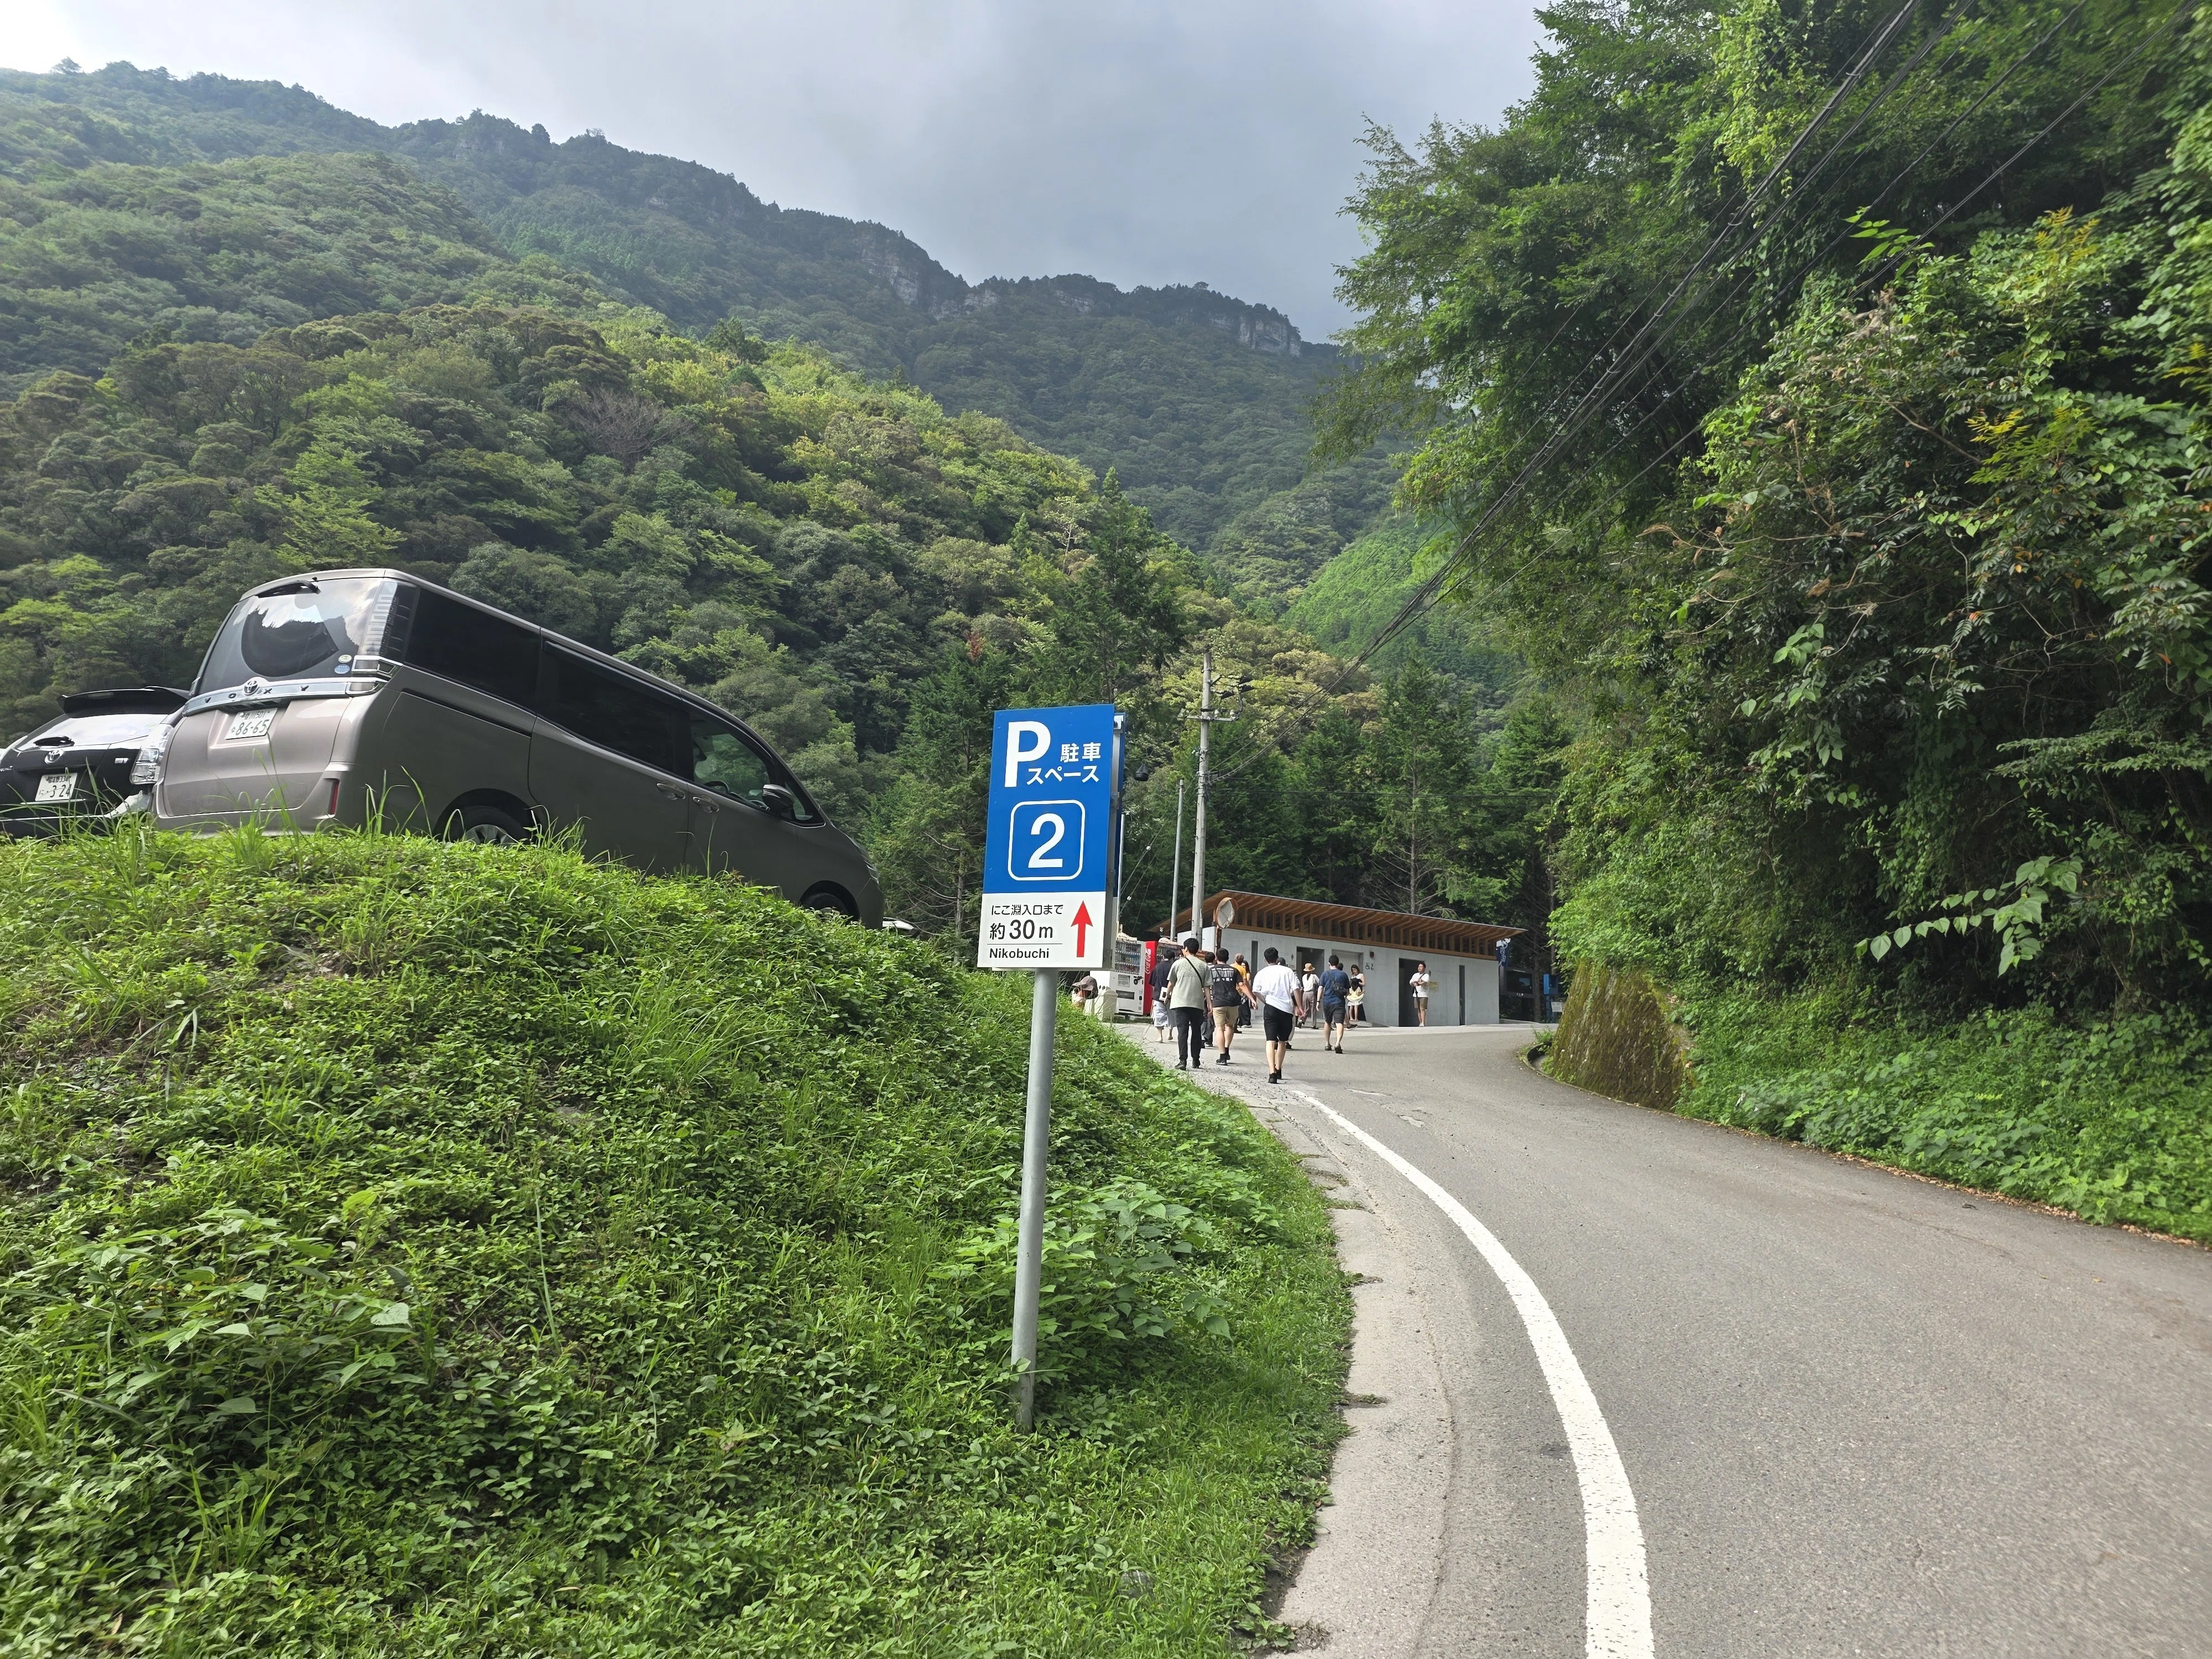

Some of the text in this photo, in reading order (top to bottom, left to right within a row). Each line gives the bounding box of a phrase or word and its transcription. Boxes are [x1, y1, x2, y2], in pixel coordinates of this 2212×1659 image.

[205, 685, 309, 703] VOXY
[1004, 721, 1051, 787] P
[1060, 742, 1101, 763] 駐車
[1026, 765, 1099, 785] スペース
[1027, 813, 1065, 869] 2
[992, 904, 1063, 915] にこ淵入口まで
[989, 948, 1049, 958] Nikobuchi
